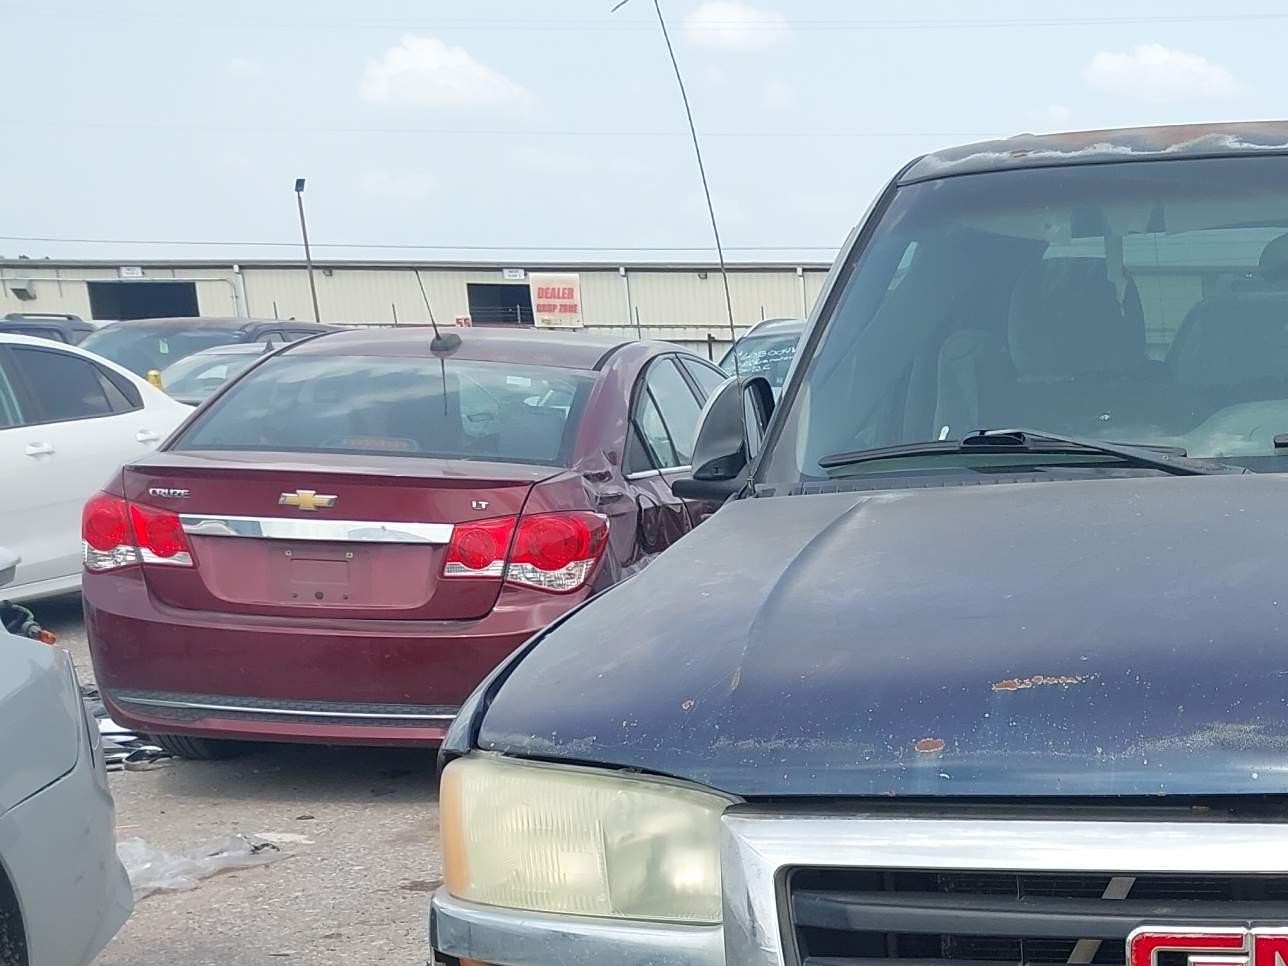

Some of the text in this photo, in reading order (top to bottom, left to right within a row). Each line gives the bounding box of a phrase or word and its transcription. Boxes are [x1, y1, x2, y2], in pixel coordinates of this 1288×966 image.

[537, 287, 574, 299] DEALER
[149, 487, 191, 499] CRUZE
[471, 500, 489, 510] LT
